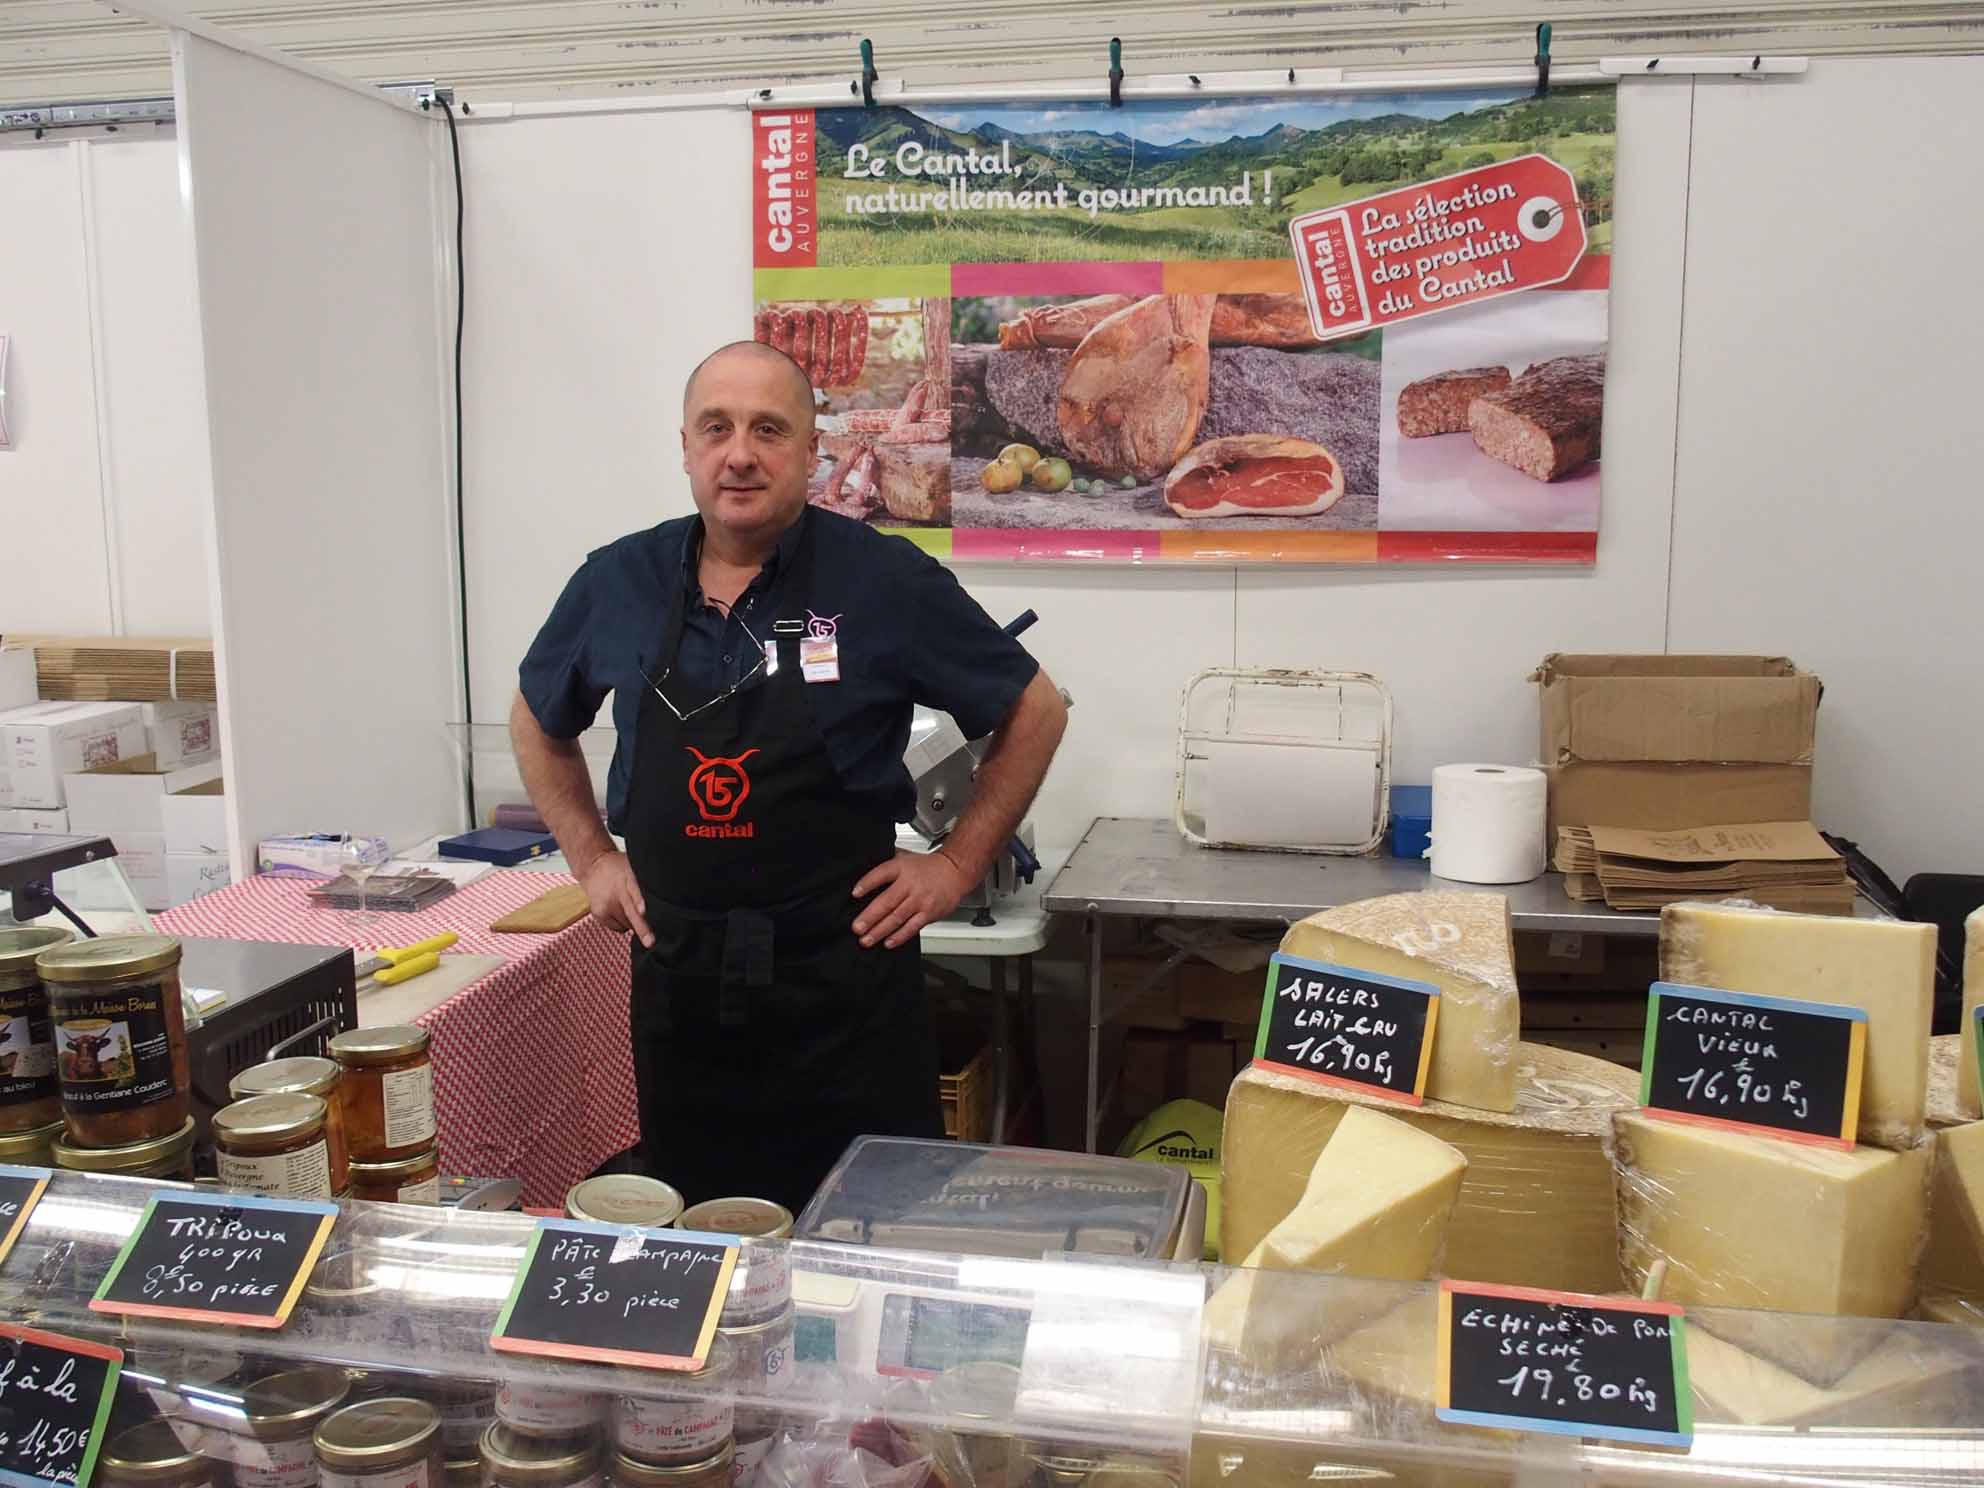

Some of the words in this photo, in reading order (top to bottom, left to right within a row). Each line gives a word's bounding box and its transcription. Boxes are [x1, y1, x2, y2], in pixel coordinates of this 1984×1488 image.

[843, 143, 887, 178] Le
[896, 139, 1023, 178] Cantal,
[760, 115, 793, 252] cantal
[795, 113, 811, 252] AUVERGNE
[845, 176, 1068, 214] naturellement
[1078, 170, 1254, 218] gourmand
[1361, 207, 1400, 236] La
[1406, 183, 1517, 223] sélection
[1365, 216, 1485, 258] tradition
[1371, 260, 1411, 285] des
[1416, 231, 1521, 279] produits
[1308, 229, 1346, 318] cantal
[1330, 227, 1359, 313] AUVERGNE
[1378, 291, 1414, 315] du
[1419, 259, 1515, 303] Cantal
[699, 769, 738, 807] 15
[686, 822, 753, 838] cantal
[1280, 978, 1380, 1008] SALERS
[1345, 1017, 1397, 1037] CRU
[1667, 1007, 1774, 1030] CANTAL
[1157, 1145, 1215, 1159] cantal
[179, 1244, 224, 1265] 400
[629, 1247, 725, 1276] AMPAGNE
[43, 1358, 78, 1403] la
